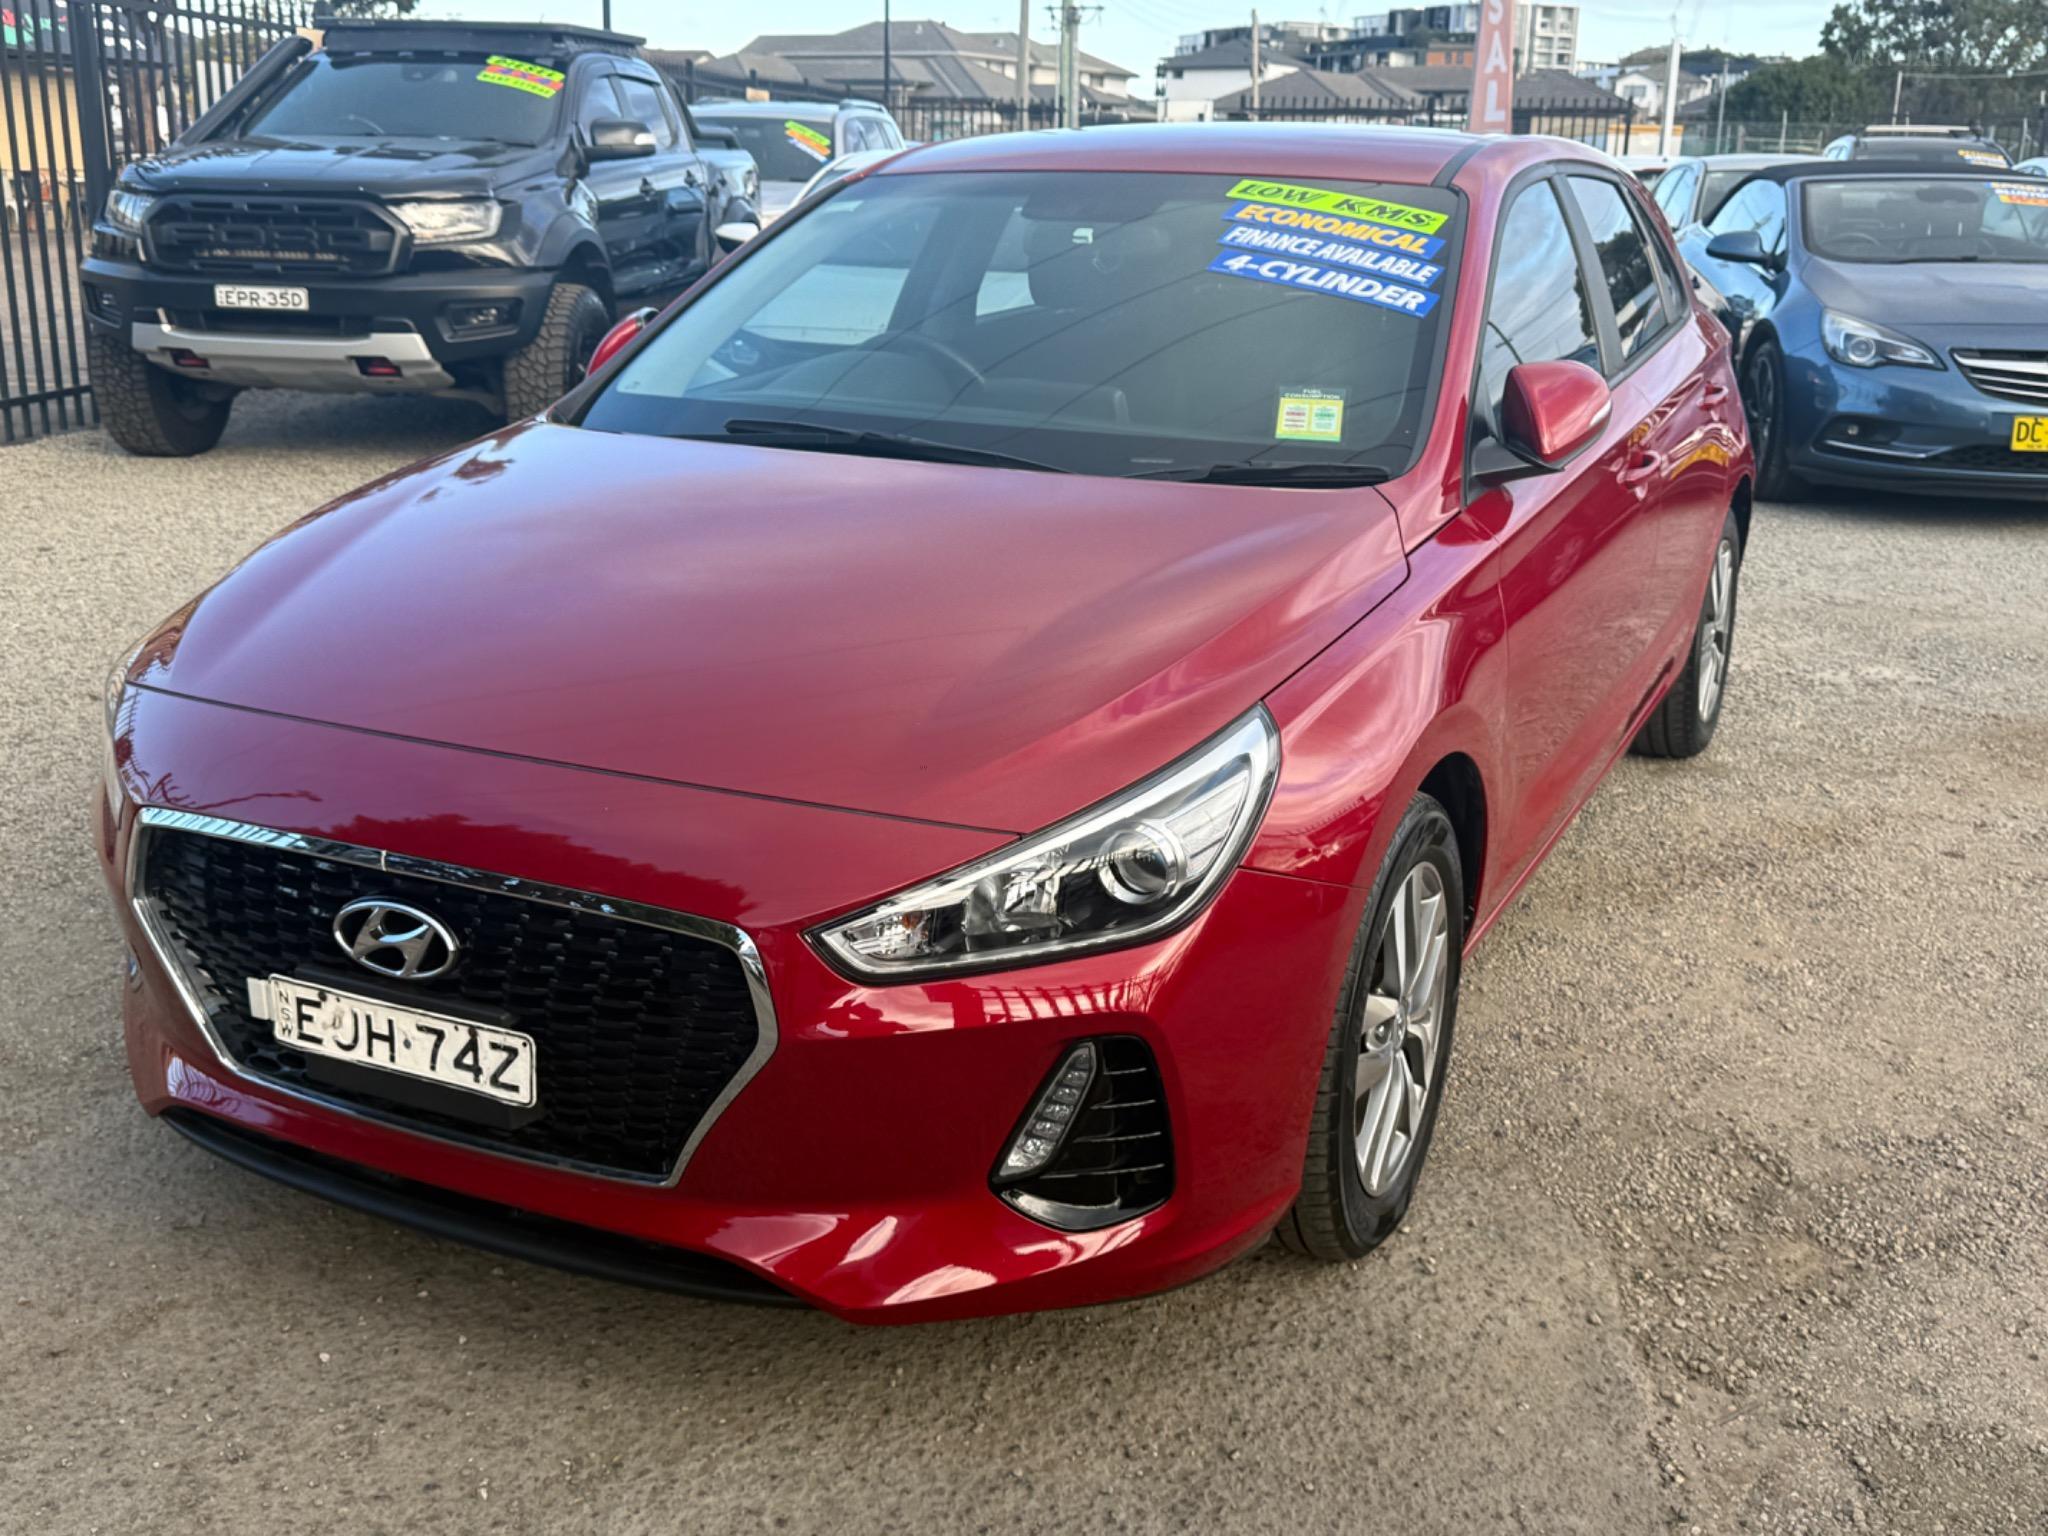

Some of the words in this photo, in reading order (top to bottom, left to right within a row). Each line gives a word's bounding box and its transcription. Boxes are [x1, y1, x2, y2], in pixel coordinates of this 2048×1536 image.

[1483, 0, 1507, 134] SAL
[1235, 204, 1430, 254] ECONOMICAL
[1237, 183, 1326, 204] LOW
[1332, 198, 1438, 228] KMS
[1224, 226, 1325, 257] FINANCE
[1312, 242, 1438, 283] AVAILABLE
[1222, 254, 1427, 312] 4-CYLINDER
[278, 990, 293, 1036] NSW
